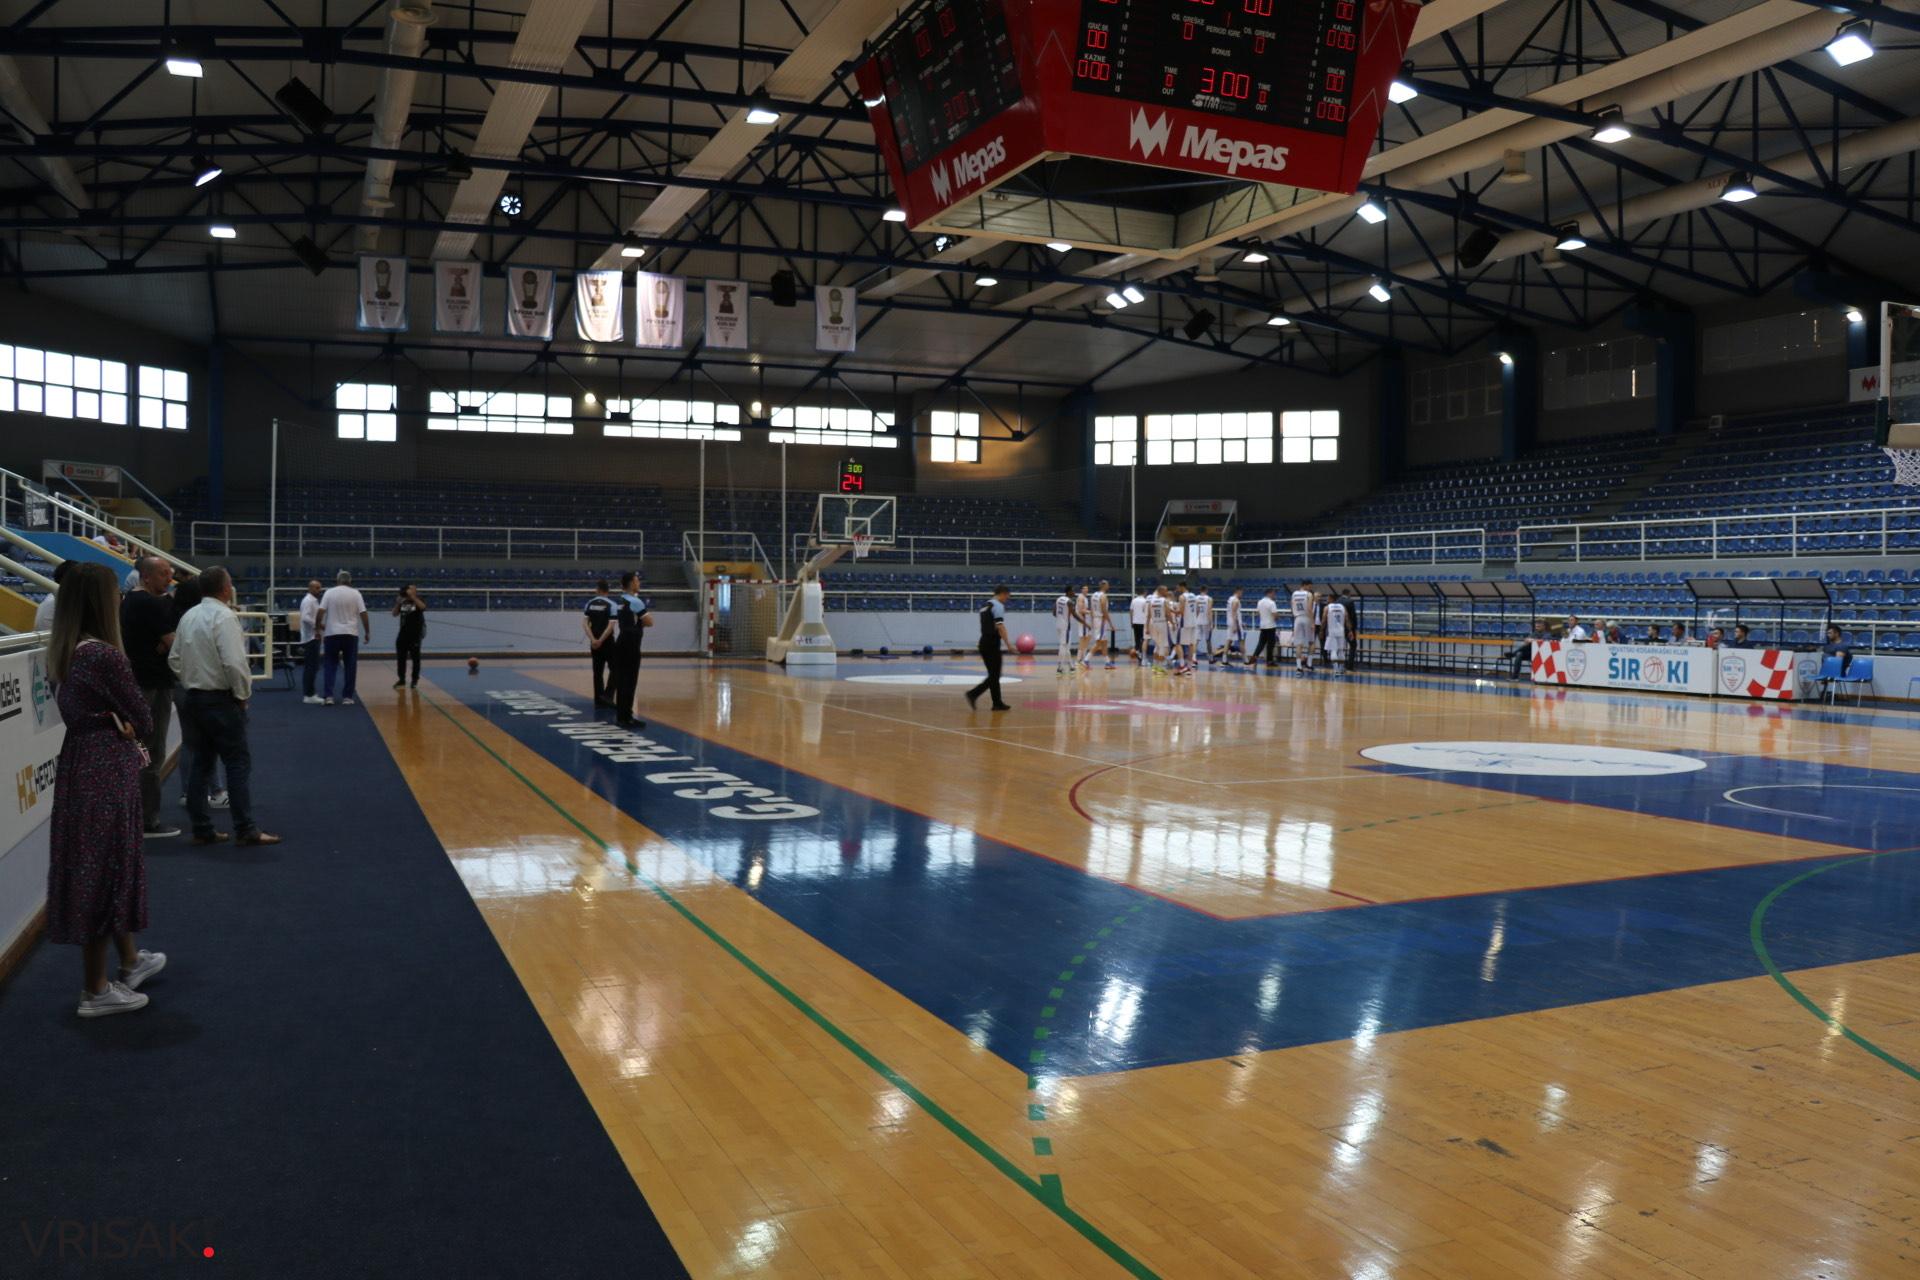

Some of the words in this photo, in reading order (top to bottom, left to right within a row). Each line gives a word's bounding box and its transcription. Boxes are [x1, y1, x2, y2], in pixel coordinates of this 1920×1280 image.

[1084, 53, 1106, 62] KAZNE
[1211, 47, 1232, 57] BONUS
[1163, 66, 1179, 75] TIME
[1162, 87, 1175, 96] OUT
[1179, 125, 1289, 175] Mepas
[953, 136, 1007, 189] Mepas
[842, 474, 862, 490] 24
[547, 721, 695, 763] PECARA
[644, 766, 821, 820] G.S.D.
